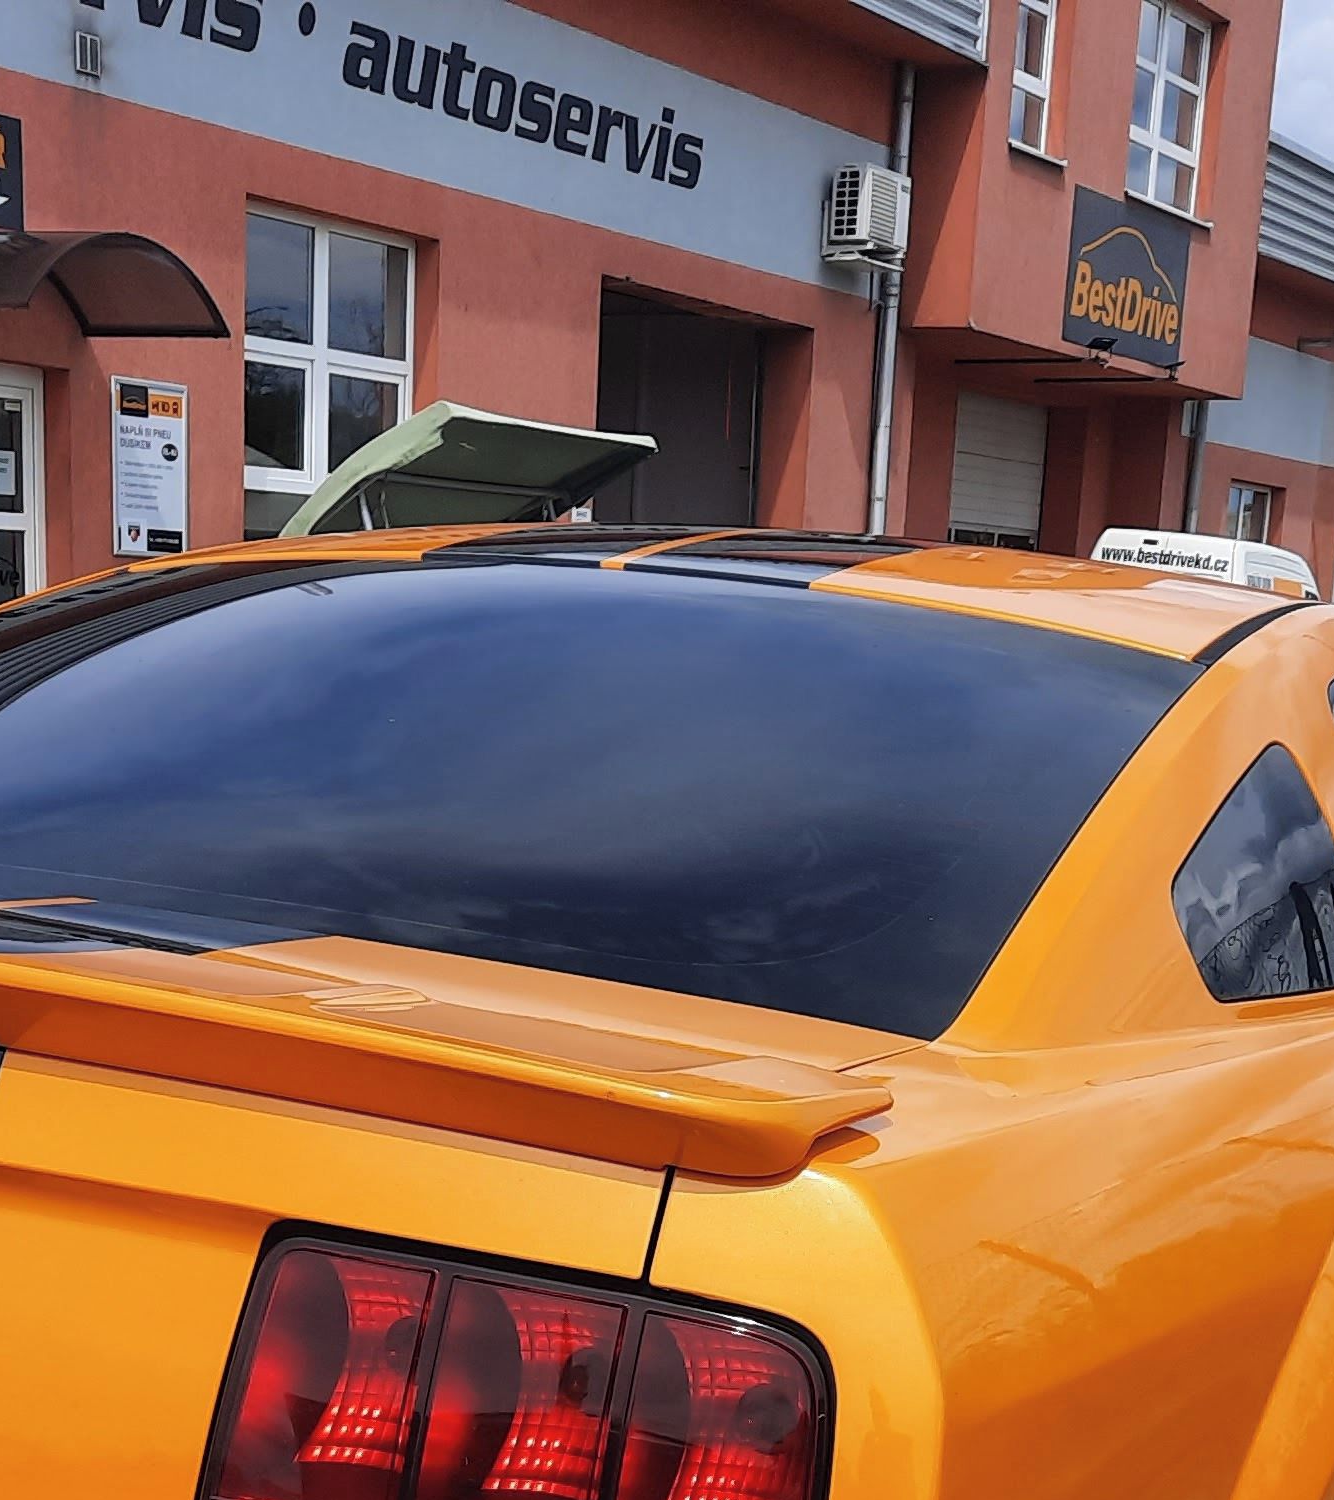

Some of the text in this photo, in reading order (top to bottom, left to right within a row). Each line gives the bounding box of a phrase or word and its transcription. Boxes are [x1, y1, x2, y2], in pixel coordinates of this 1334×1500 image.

[79, 0, 704, 190] vis autoservis
[1070, 259, 1179, 345] BestDrive
[1101, 547, 1228, 573] www.bestdrivekd.cz
